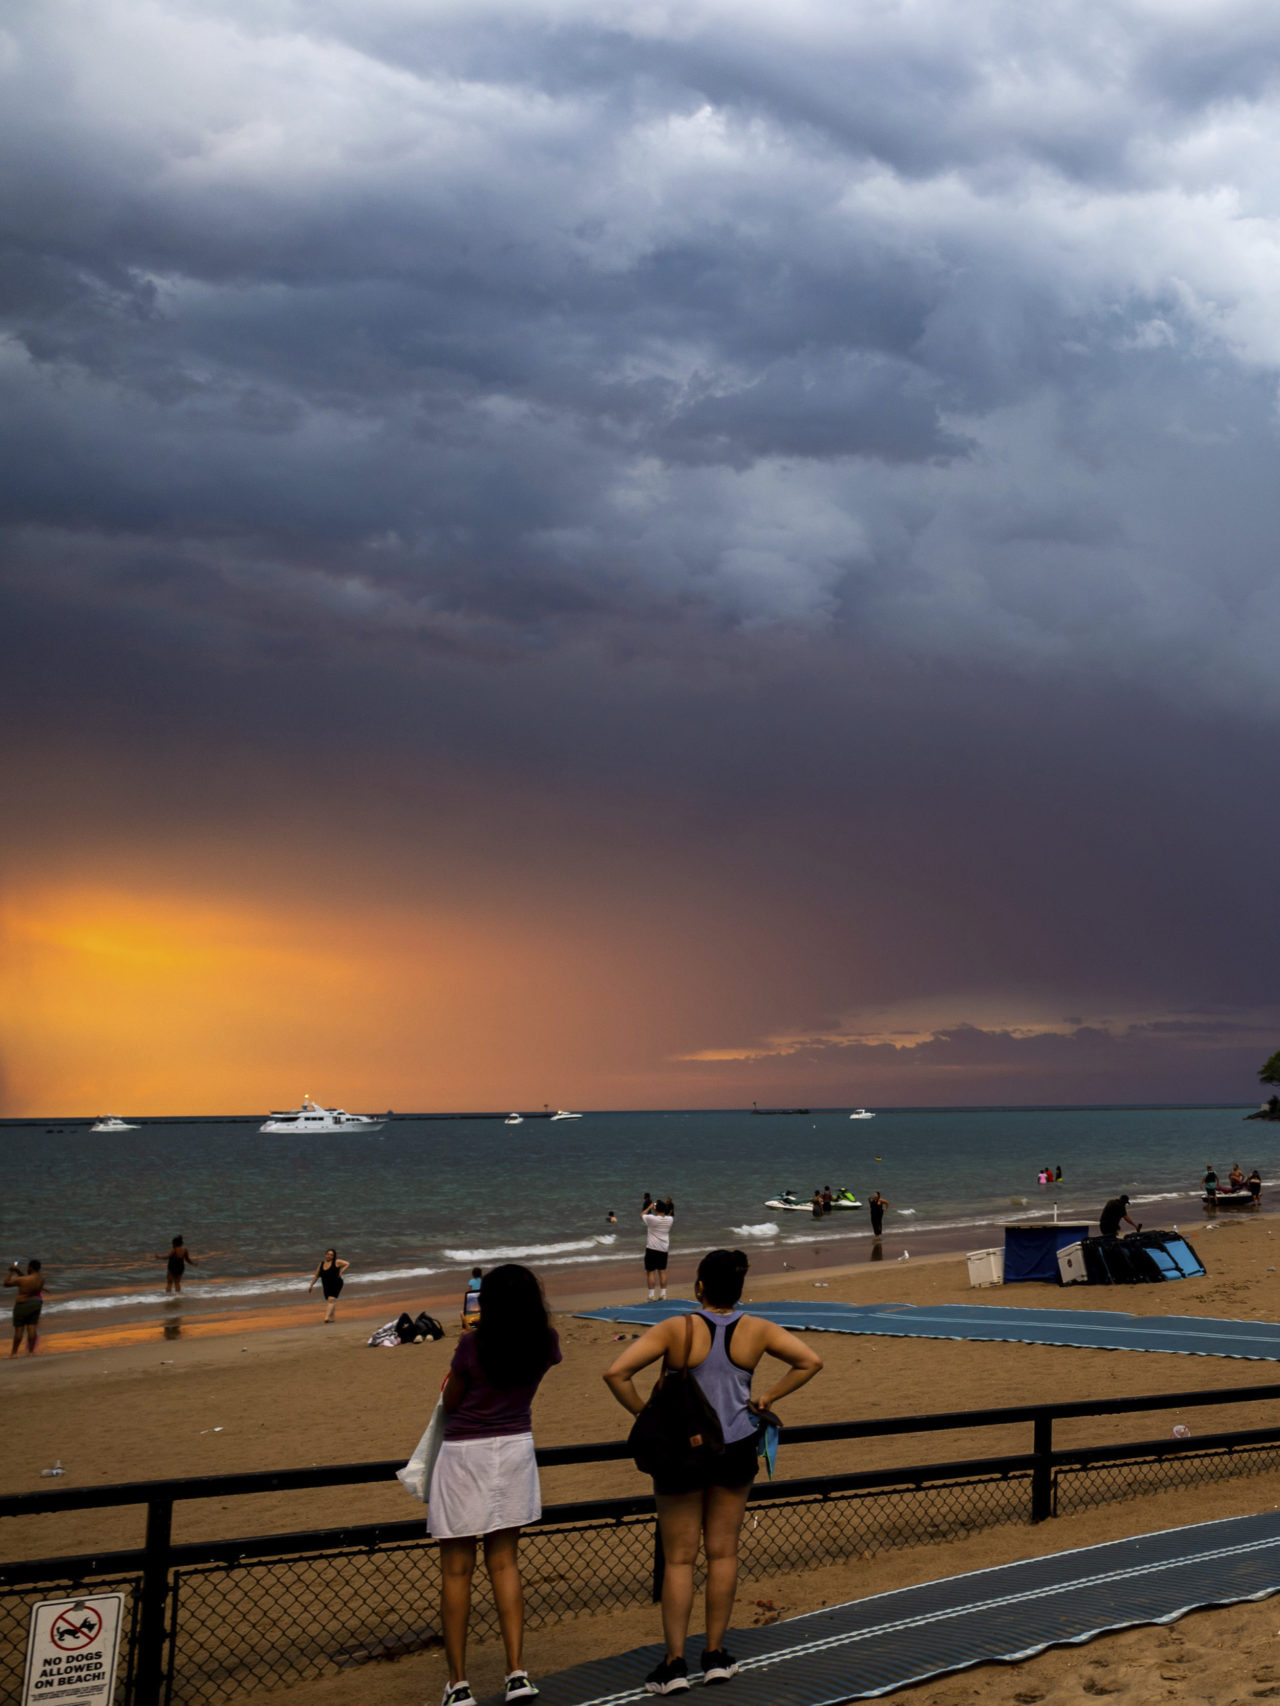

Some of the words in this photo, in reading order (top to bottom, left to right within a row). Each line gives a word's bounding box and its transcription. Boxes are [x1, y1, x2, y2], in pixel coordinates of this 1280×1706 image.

[42, 1657, 62, 1666] NO
[66, 1651, 102, 1664] DOGS
[40, 1662, 102, 1678] ALLOWED
[34, 1679, 54, 1689] ON
[58, 1672, 106, 1686] BEACH!
